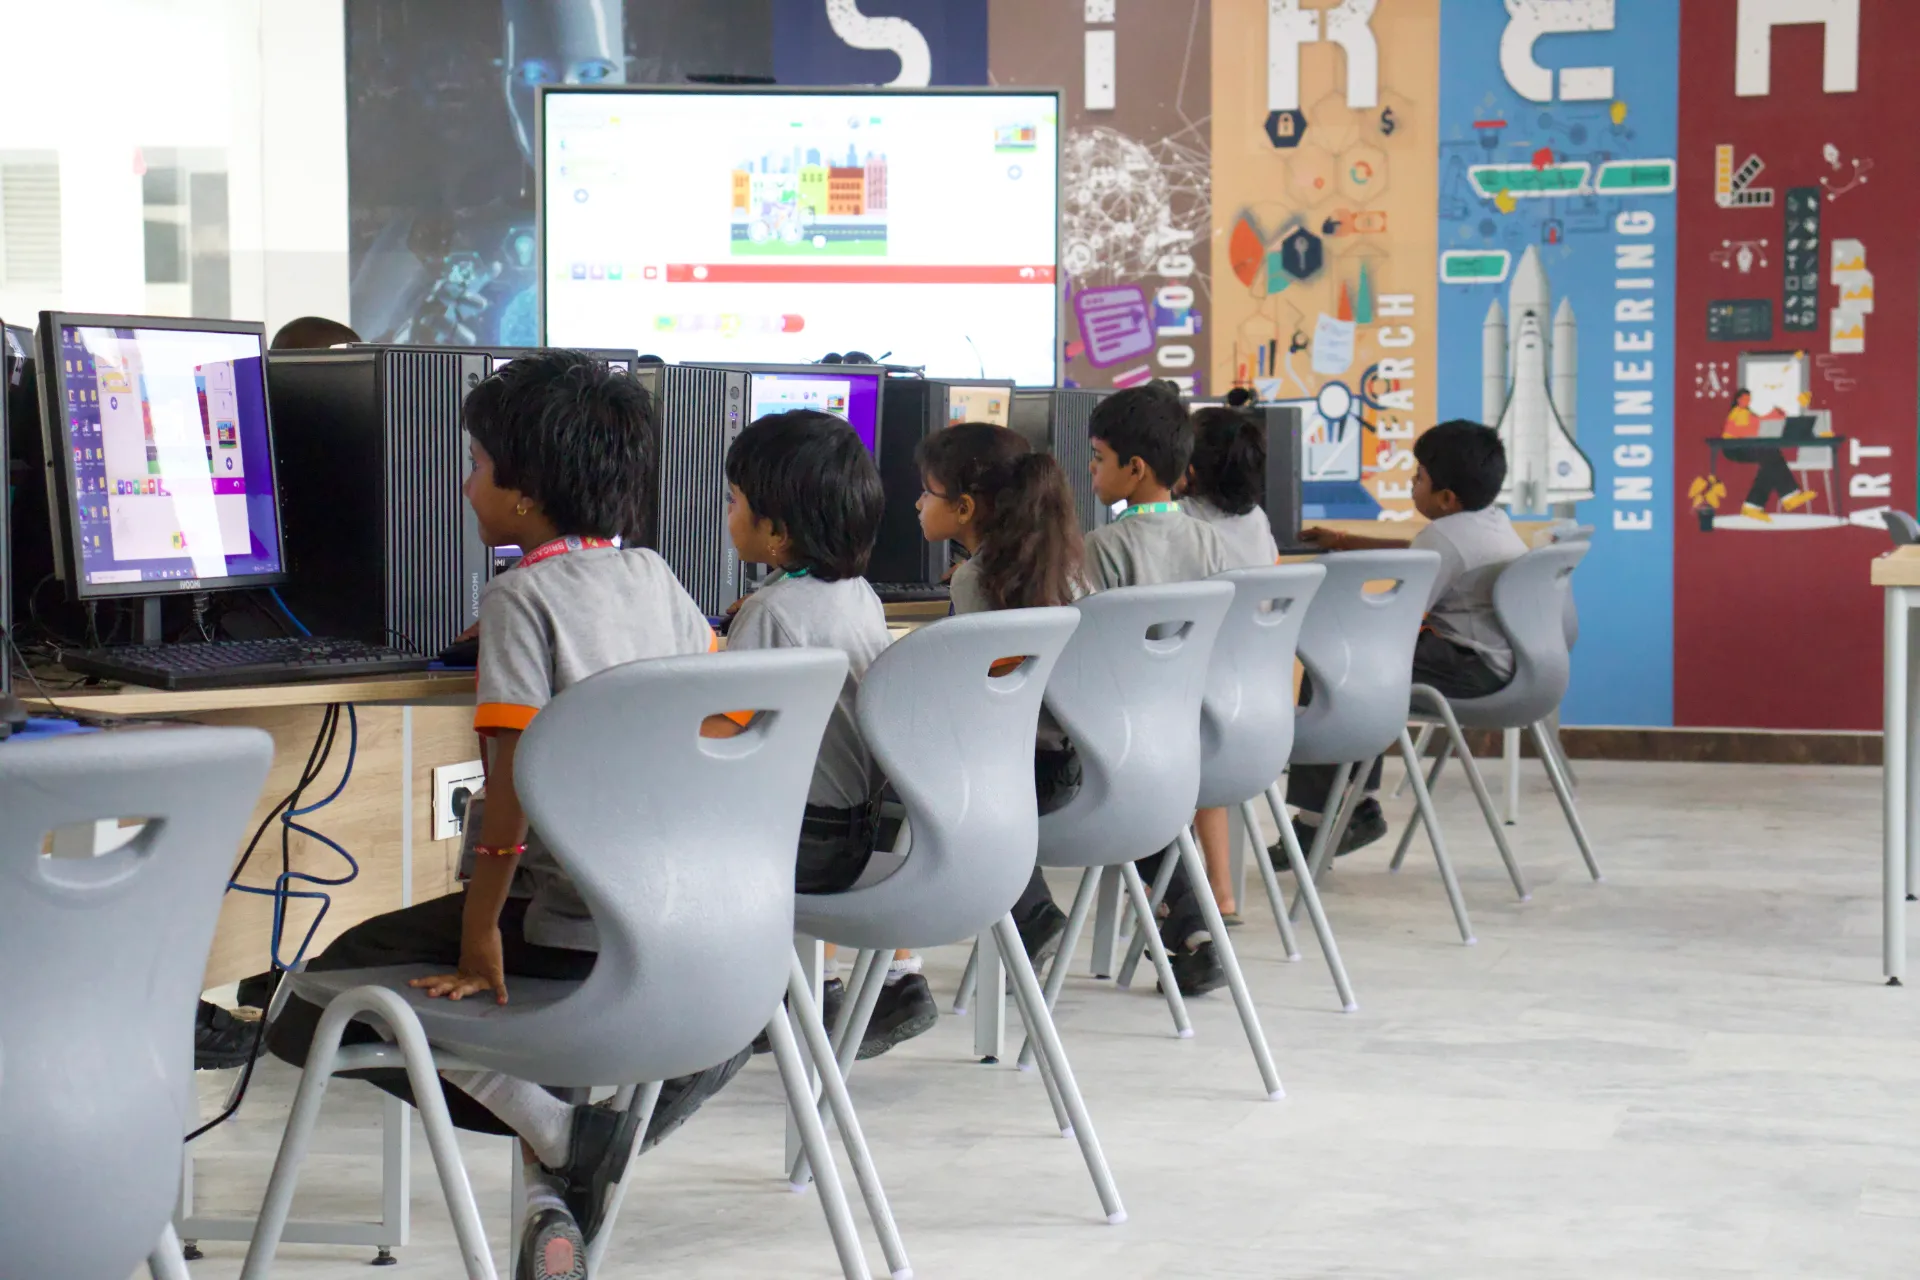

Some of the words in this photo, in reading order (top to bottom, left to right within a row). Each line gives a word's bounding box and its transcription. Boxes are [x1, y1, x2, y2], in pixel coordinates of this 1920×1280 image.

[1157, 222, 1195, 396] NOLOGY
[1377, 294, 1415, 522] RESEARCH
[1613, 210, 1656, 531] ENGINEERING
[1848, 437, 1892, 531] ART
